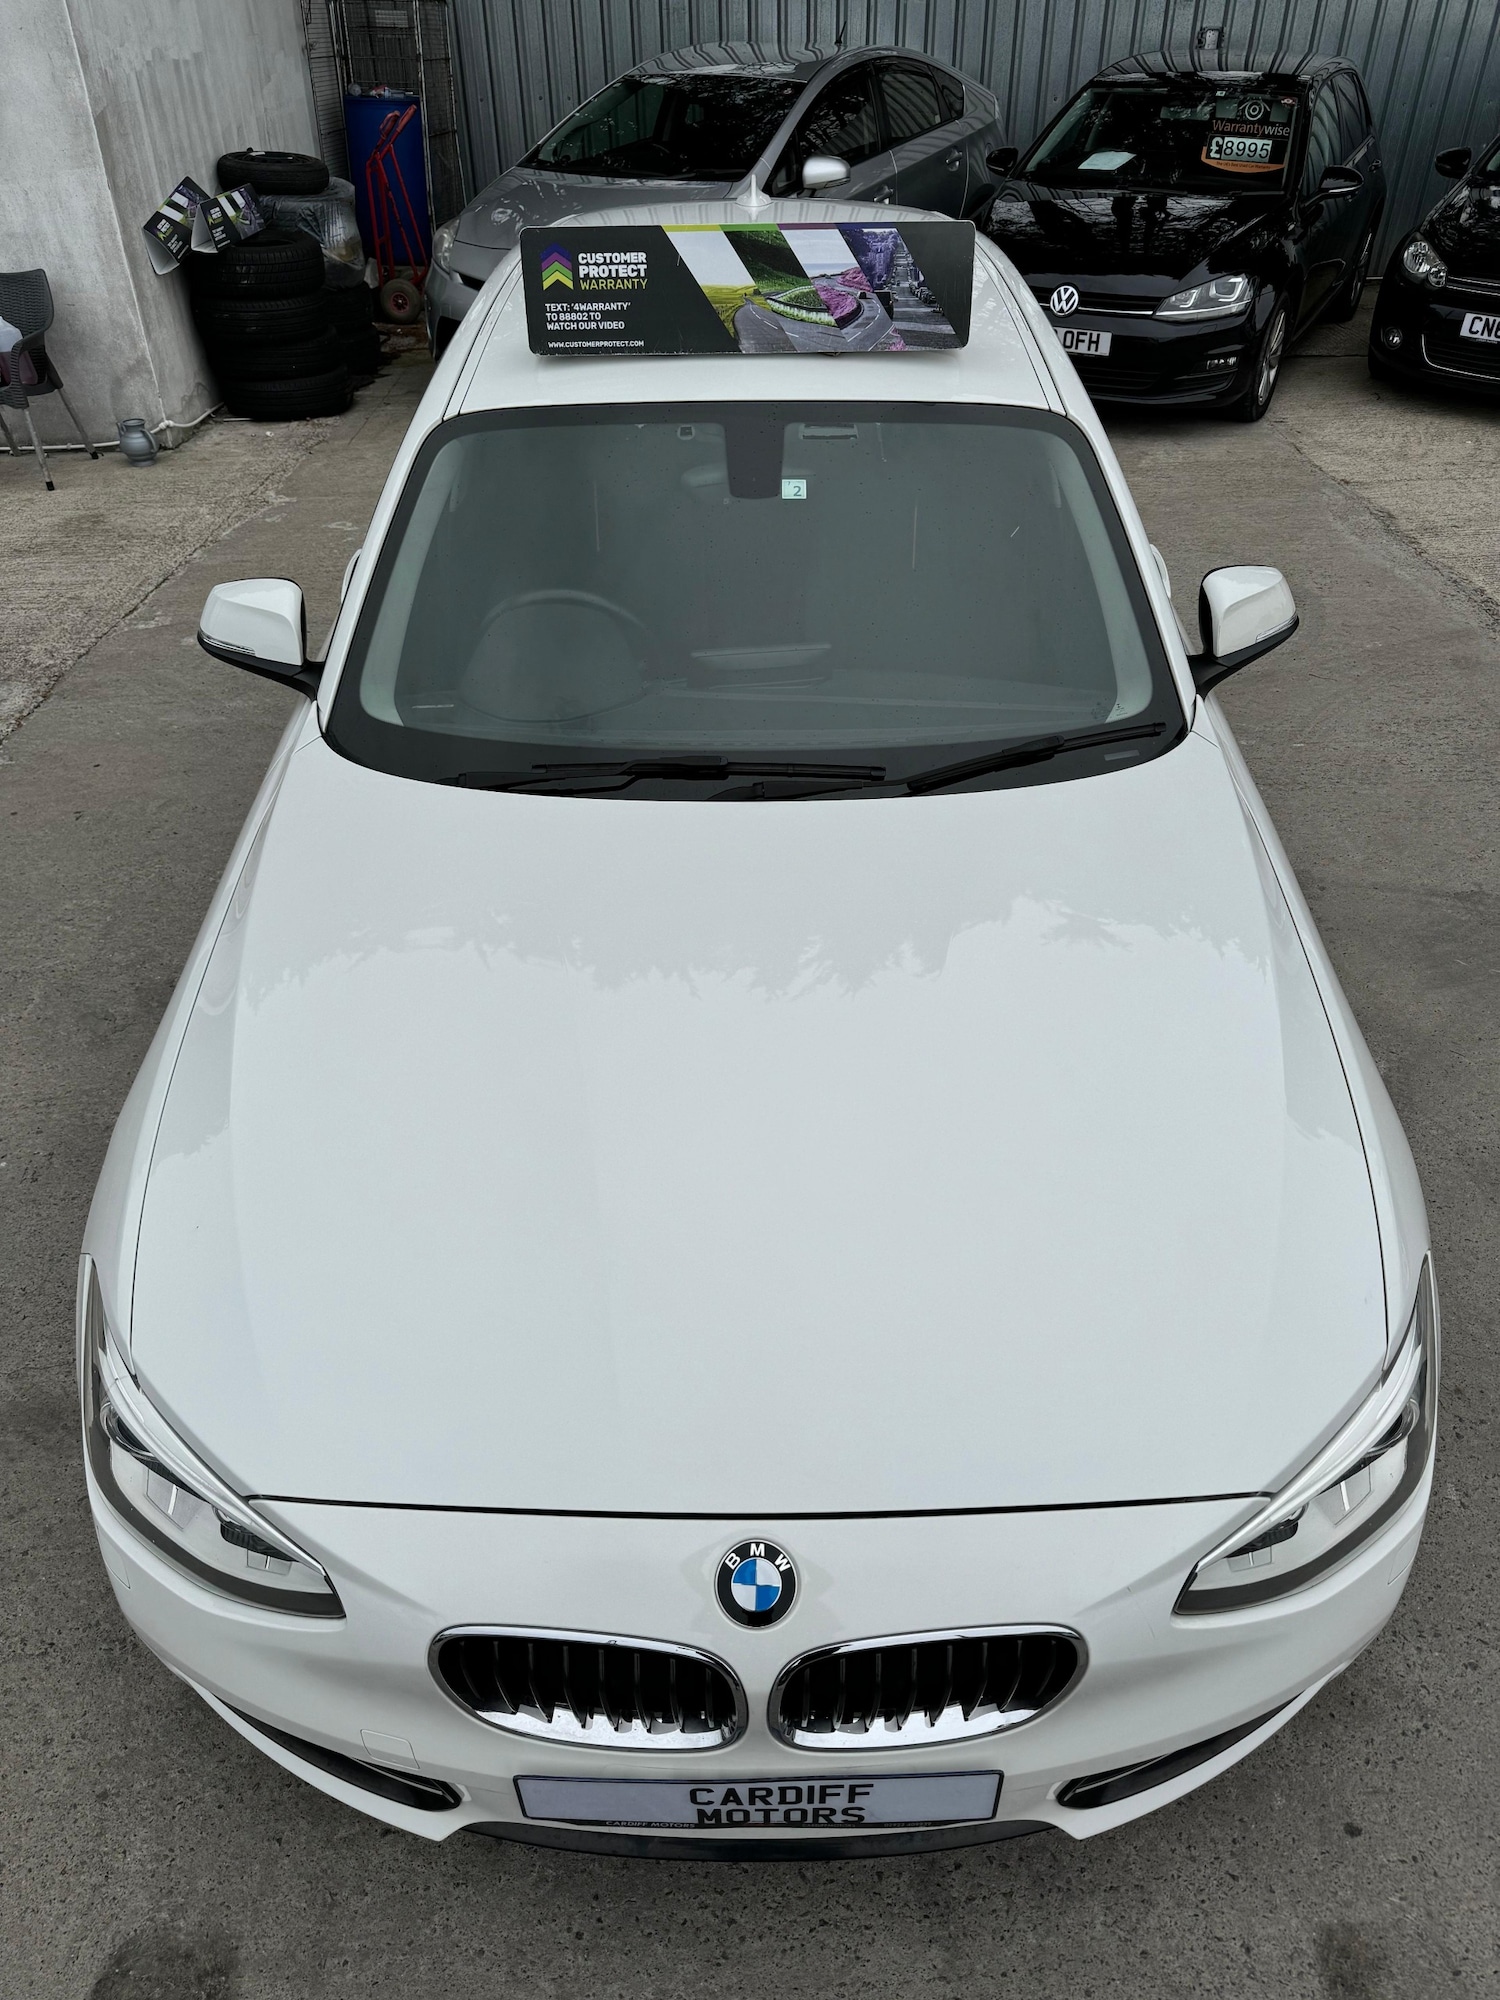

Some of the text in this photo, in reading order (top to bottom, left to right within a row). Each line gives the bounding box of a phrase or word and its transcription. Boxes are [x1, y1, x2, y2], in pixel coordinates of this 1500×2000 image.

[1213, 120, 1290, 136] Warrantywise
[1210, 137, 1271, 159] £8995
[578, 252, 647, 264] CUSTOMER
[579, 264, 648, 278] PROTECT
[580, 279, 648, 290] WARRANTY
[545, 303, 570, 311] TEXT:
[546, 312, 602, 321] TO 88802 TO
[547, 321, 625, 330] WATCH OUR VIDEO
[548, 340, 645, 348] WWW.CUSTOMERPROTECT.COM
[725, 1543, 791, 1572] BMW
[690, 1784, 874, 1805] CARDIFF
[697, 1807, 866, 1824] MOTORS
